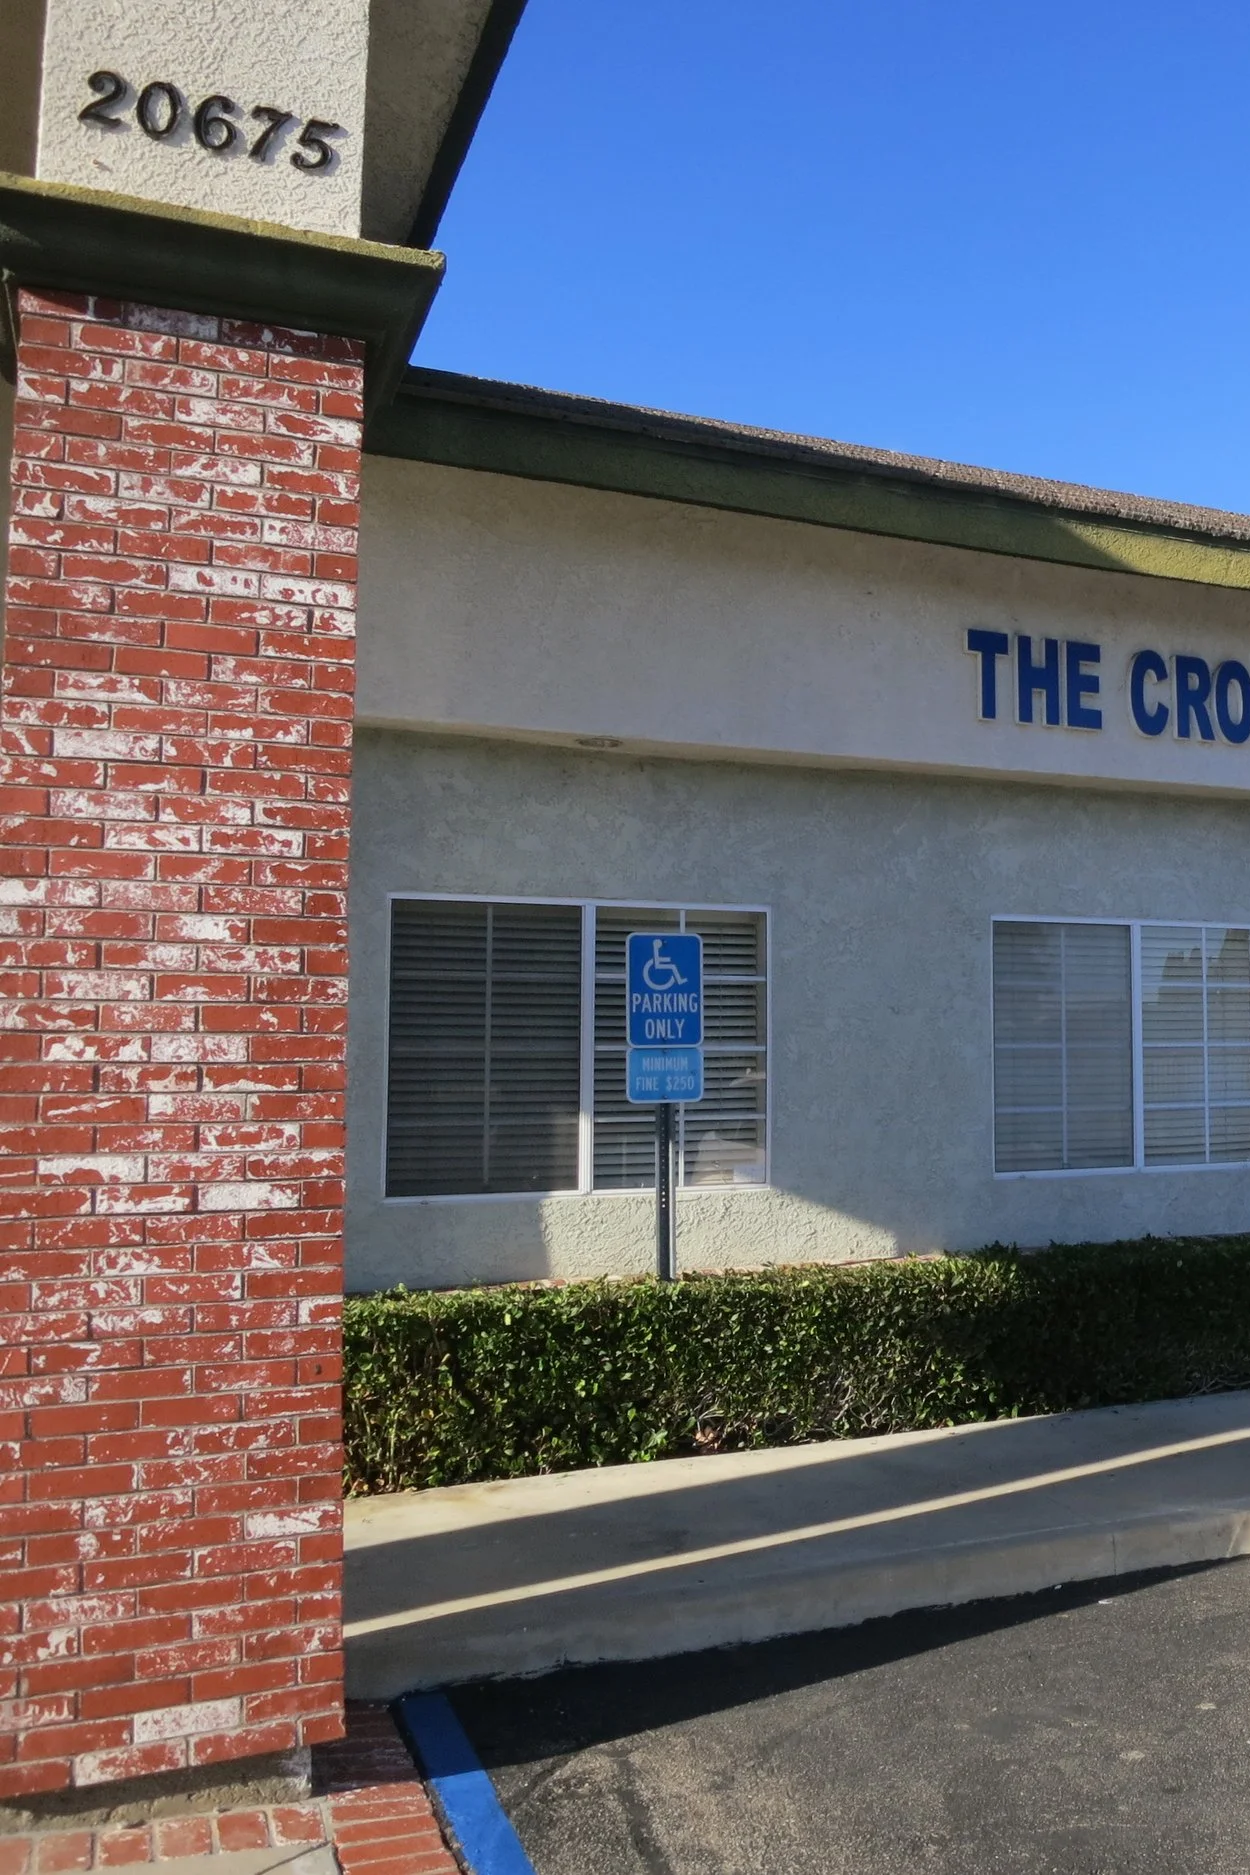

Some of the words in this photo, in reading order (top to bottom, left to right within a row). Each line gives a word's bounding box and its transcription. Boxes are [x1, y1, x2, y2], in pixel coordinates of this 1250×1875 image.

[78, 70, 340, 170] 20675
[964, 629, 1102, 731] THE
[632, 993, 698, 1012] PARKING
[645, 1019, 685, 1039] ONLY
[642, 1057, 688, 1071] MINIMUM
[636, 1076, 659, 1091] FINE
[666, 1076, 695, 1091] $250
